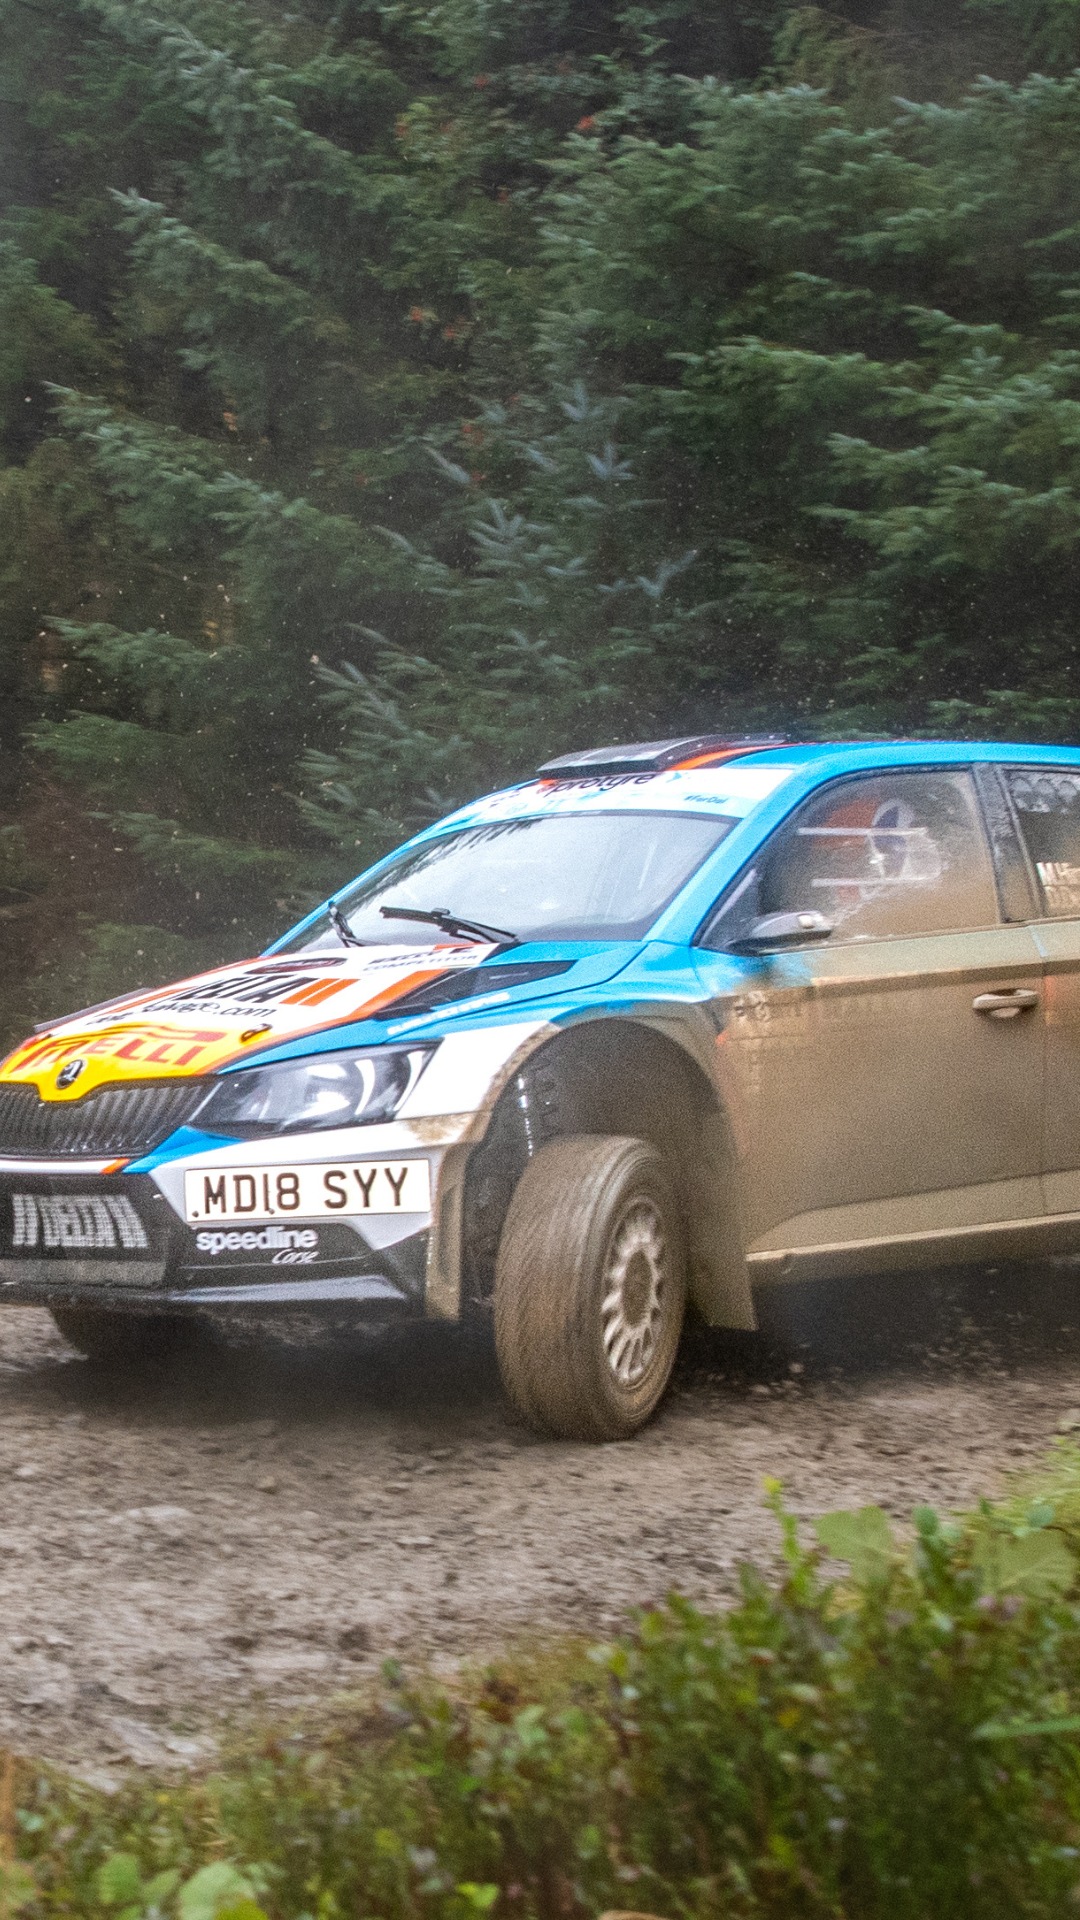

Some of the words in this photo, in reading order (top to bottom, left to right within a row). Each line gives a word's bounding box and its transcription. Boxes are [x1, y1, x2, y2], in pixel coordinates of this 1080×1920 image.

[544, 773, 657, 797] protyre
[10, 1025, 228, 1073] PIRELLI
[204, 1173, 300, 1214] MD18
[324, 1167, 408, 1209] SYY
[196, 1226, 319, 1255] speedline
[271, 1249, 319, 1265] Corse
